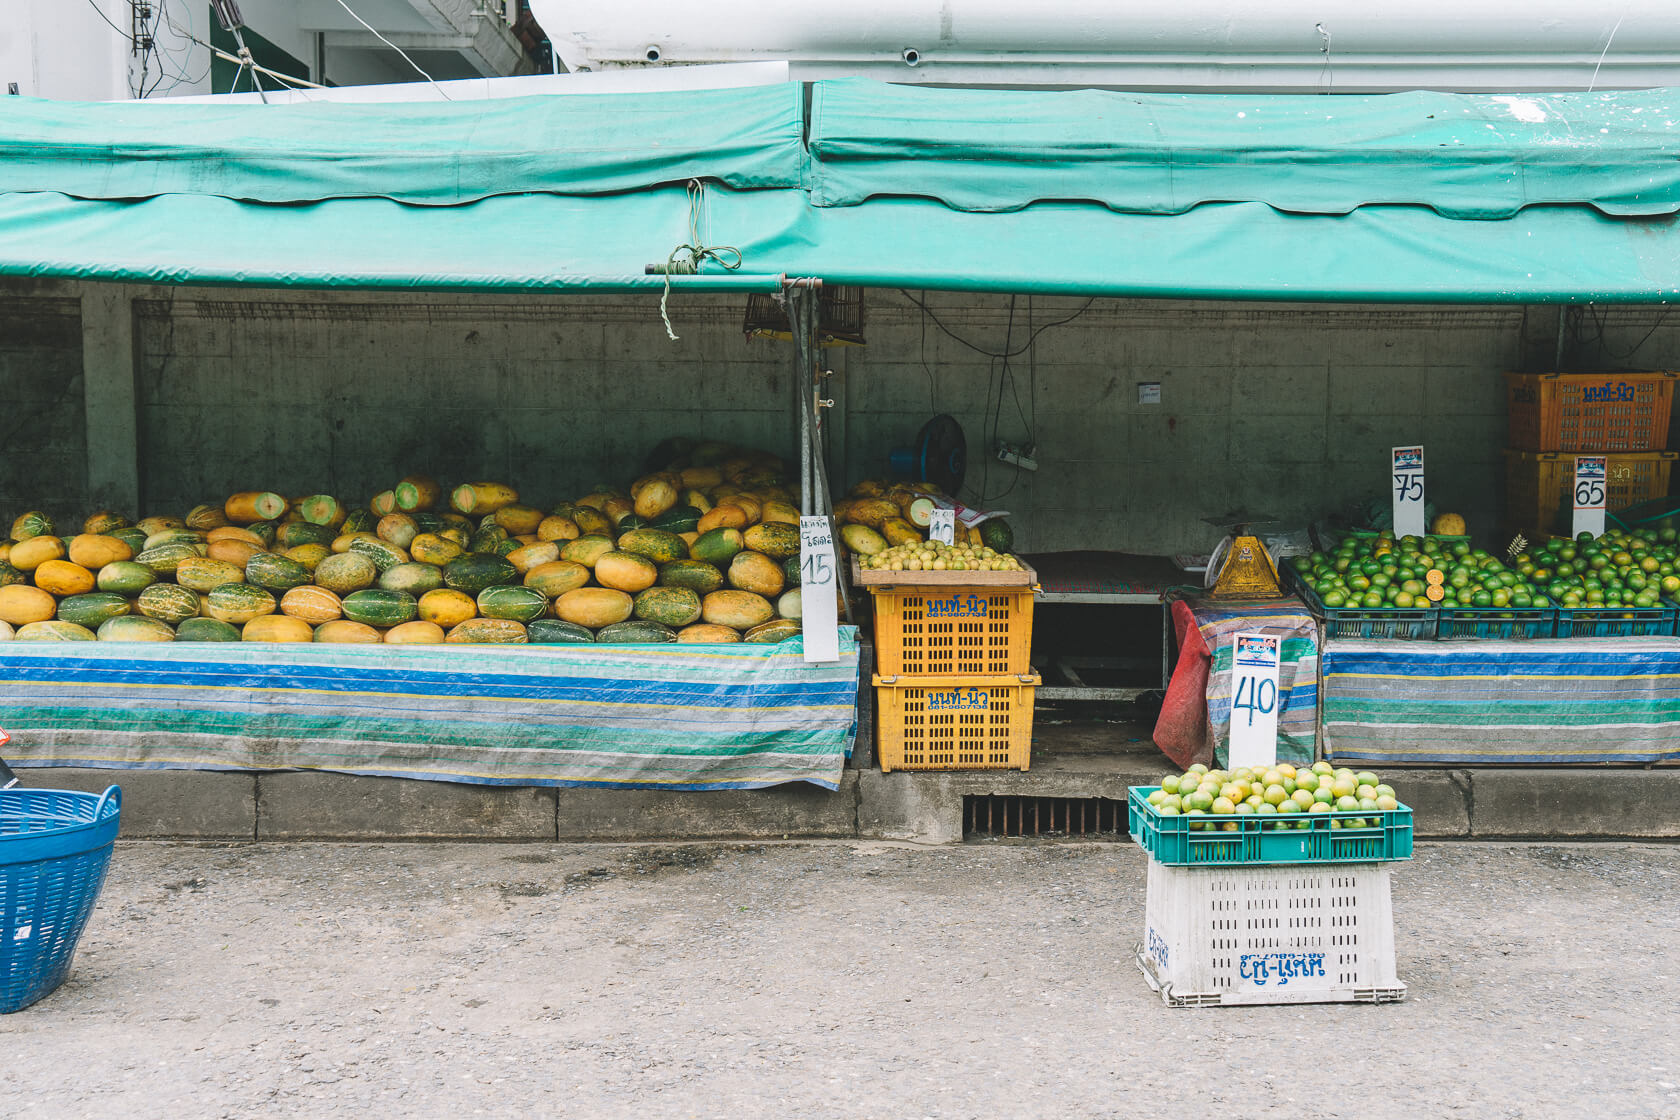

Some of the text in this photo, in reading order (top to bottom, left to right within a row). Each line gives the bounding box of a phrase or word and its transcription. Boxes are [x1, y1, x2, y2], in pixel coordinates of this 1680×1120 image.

[1394, 474, 1424, 501] 75
[1576, 480, 1605, 505] 65
[802, 554, 832, 584] 15
[927, 594, 987, 613] นนท์-นิว
[928, 687, 988, 704] นนท์-นิว
[1234, 676, 1276, 727] 40
